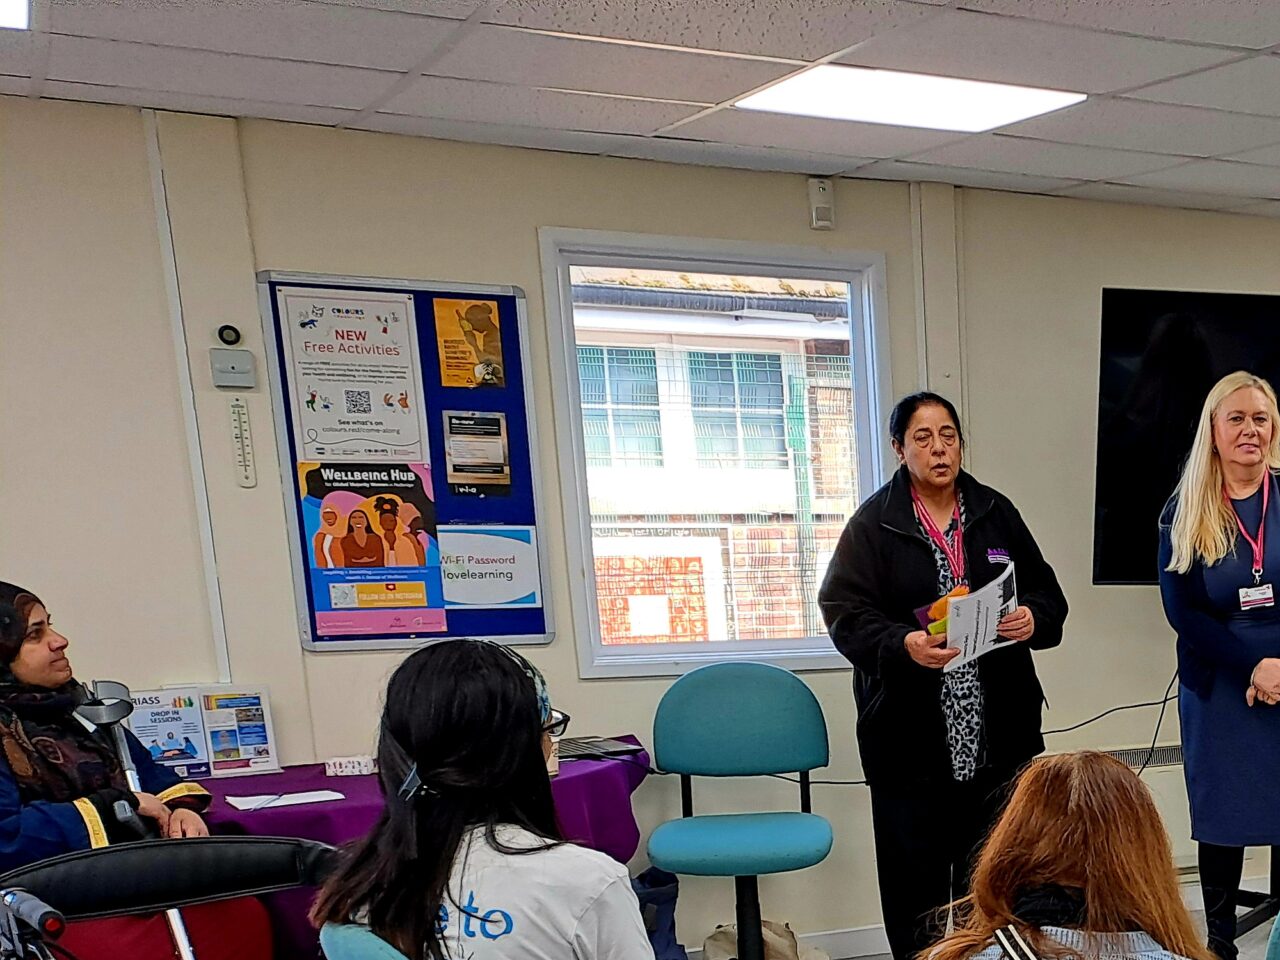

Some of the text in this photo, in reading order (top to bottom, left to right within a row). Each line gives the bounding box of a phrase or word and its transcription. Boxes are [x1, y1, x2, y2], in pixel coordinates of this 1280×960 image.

[332, 307, 365, 316] COLOURS
[335, 329, 367, 341] NEW
[304, 341, 400, 356] Free Activities
[440, 555, 516, 565] Wi-Fi Password
[443, 569, 513, 582] lovelearning
[150, 710, 171, 718] DROP
[150, 716, 183, 724] SESSIONS
[463, 890, 513, 940] to
